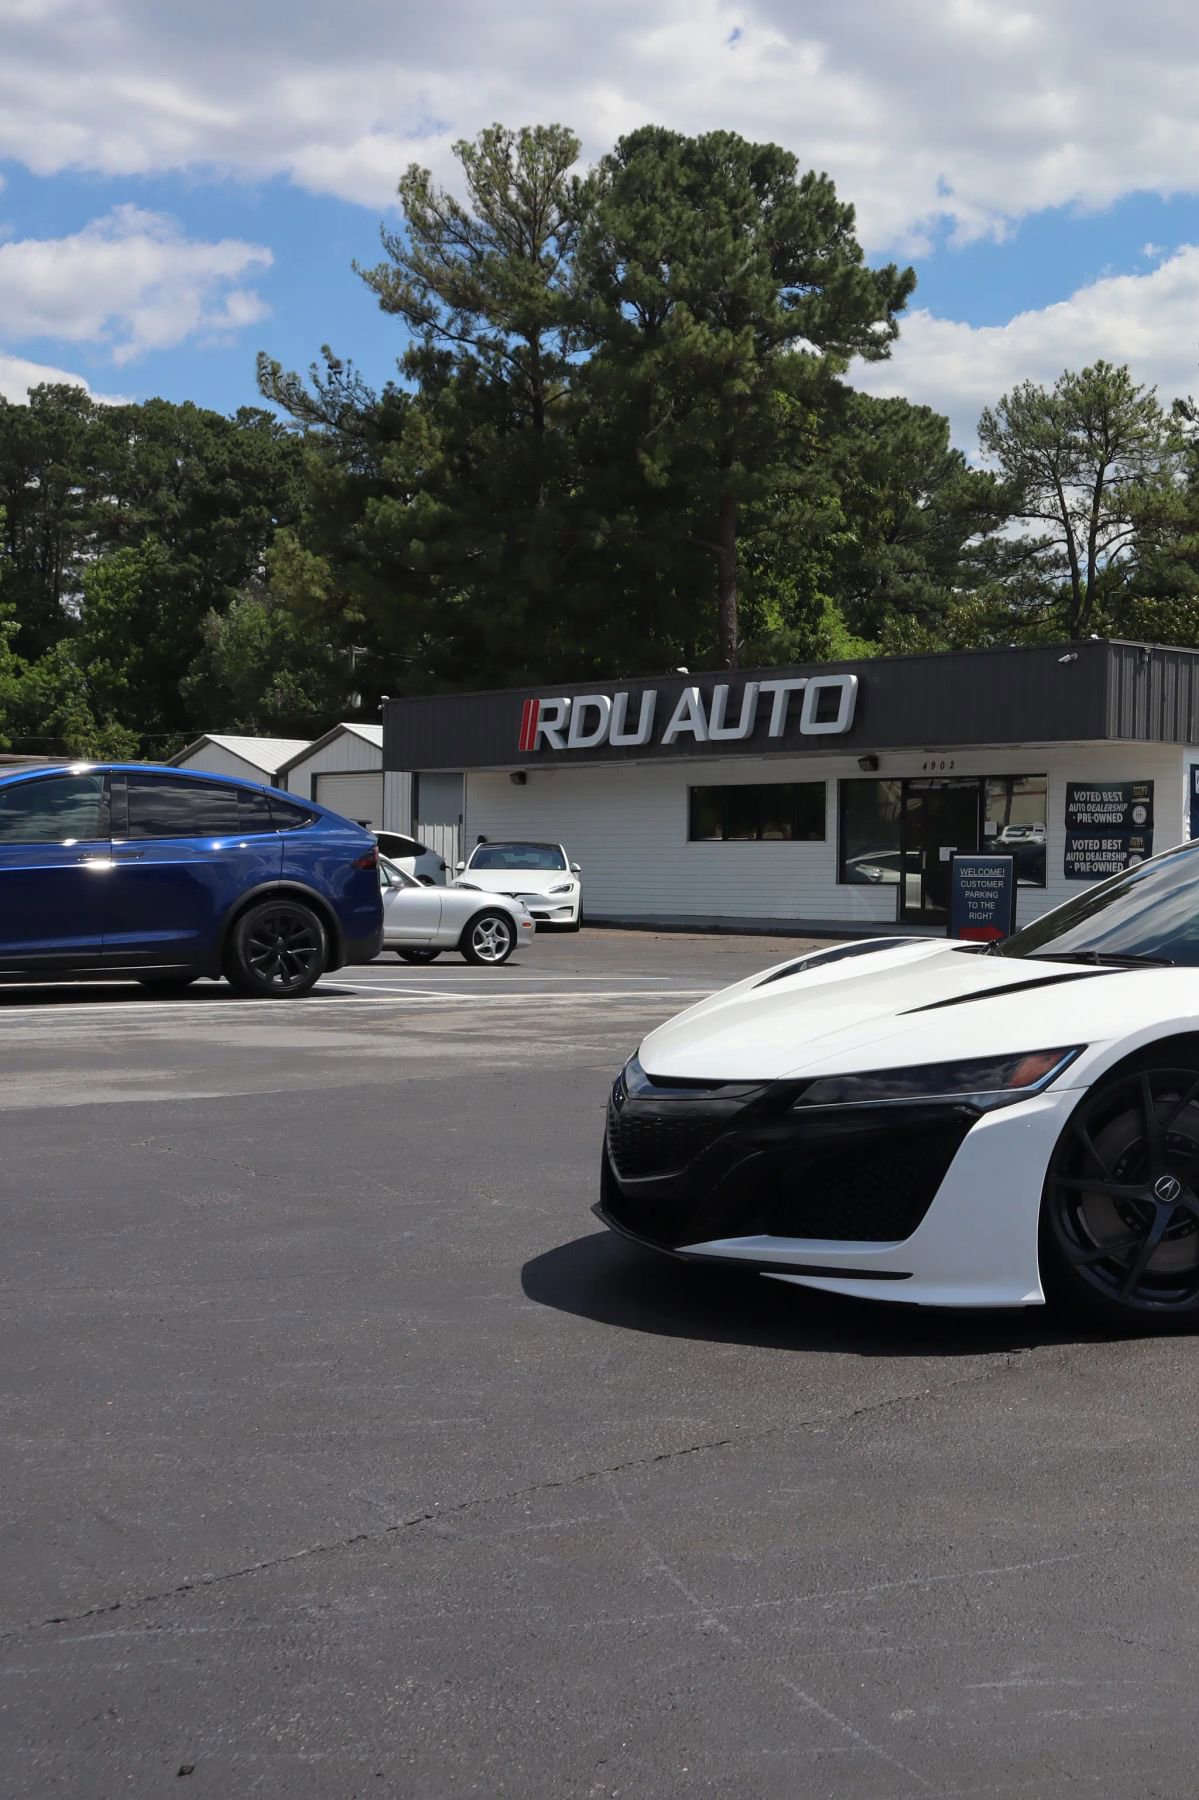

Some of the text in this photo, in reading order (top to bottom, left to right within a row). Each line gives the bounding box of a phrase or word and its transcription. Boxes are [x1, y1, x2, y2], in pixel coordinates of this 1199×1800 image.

[518, 674, 859, 752] RDU AUTO
[922, 760, 955, 770] 4902
[1073, 791, 1101, 802] VOTED
[1102, 791, 1123, 802] BEST
[1068, 803, 1128, 812] AUTO DEALERSHIP
[1071, 840, 1100, 850] VOTED
[1101, 840, 1123, 850] BEST
[1066, 852, 1128, 861] AUTO DEALERSHIP
[960, 867, 1005, 877] WELCOME!
[960, 880, 1004, 888] CUSTOMER
[965, 891, 999, 899] PARKING
[968, 901, 996, 910] TO THE
[969, 912, 993, 920] RIGHT
